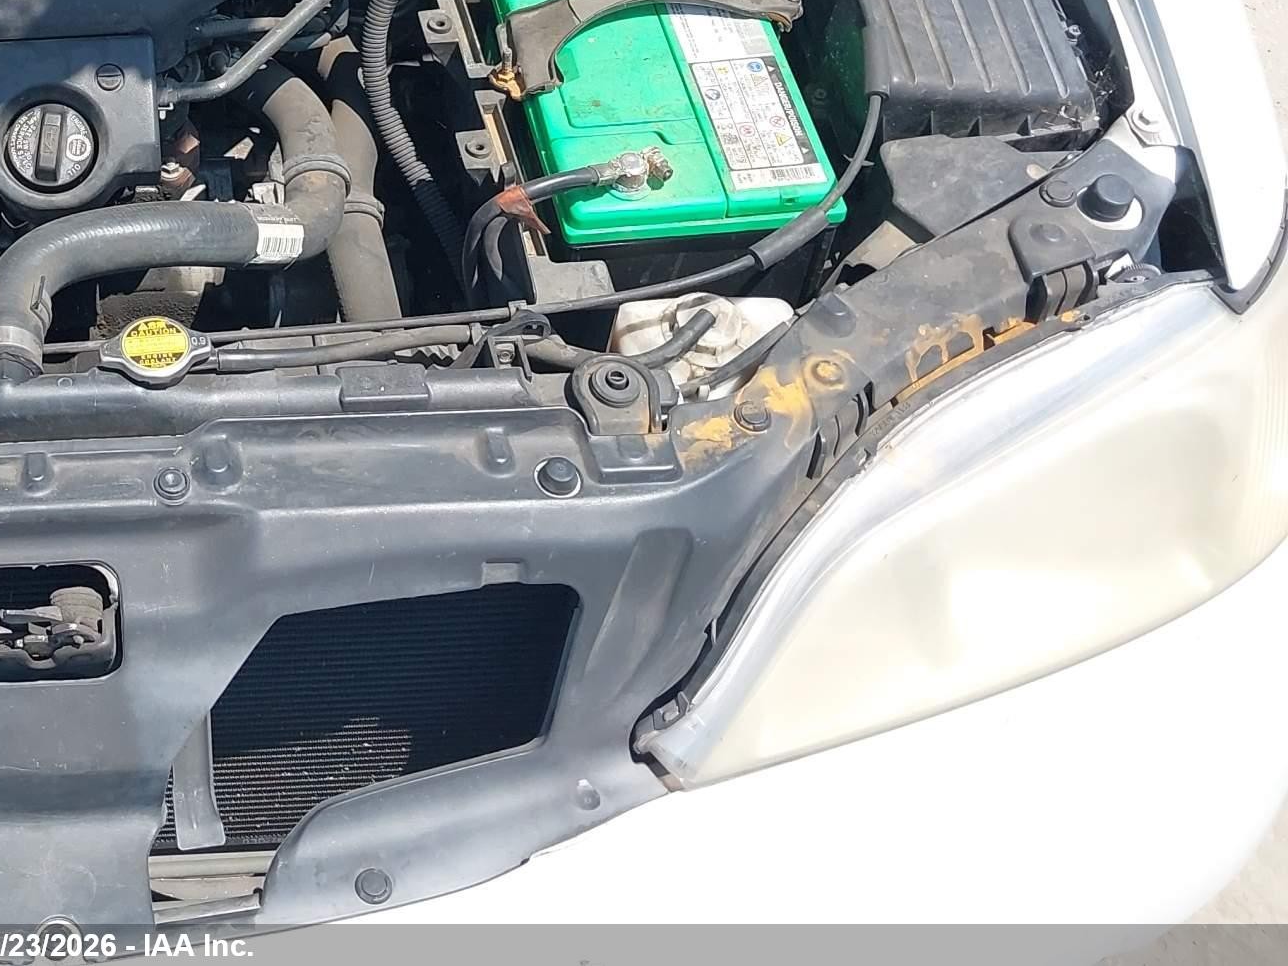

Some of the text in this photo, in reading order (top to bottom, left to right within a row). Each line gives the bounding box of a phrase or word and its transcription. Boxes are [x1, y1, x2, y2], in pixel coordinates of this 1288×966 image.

[69, 114, 88, 136] ENGINE
[15, 122, 30, 149] SERVICE
[66, 162, 82, 177] OIL
[130, 328, 177, 337] CAUTION
[191, 336, 206, 346] 0.9
